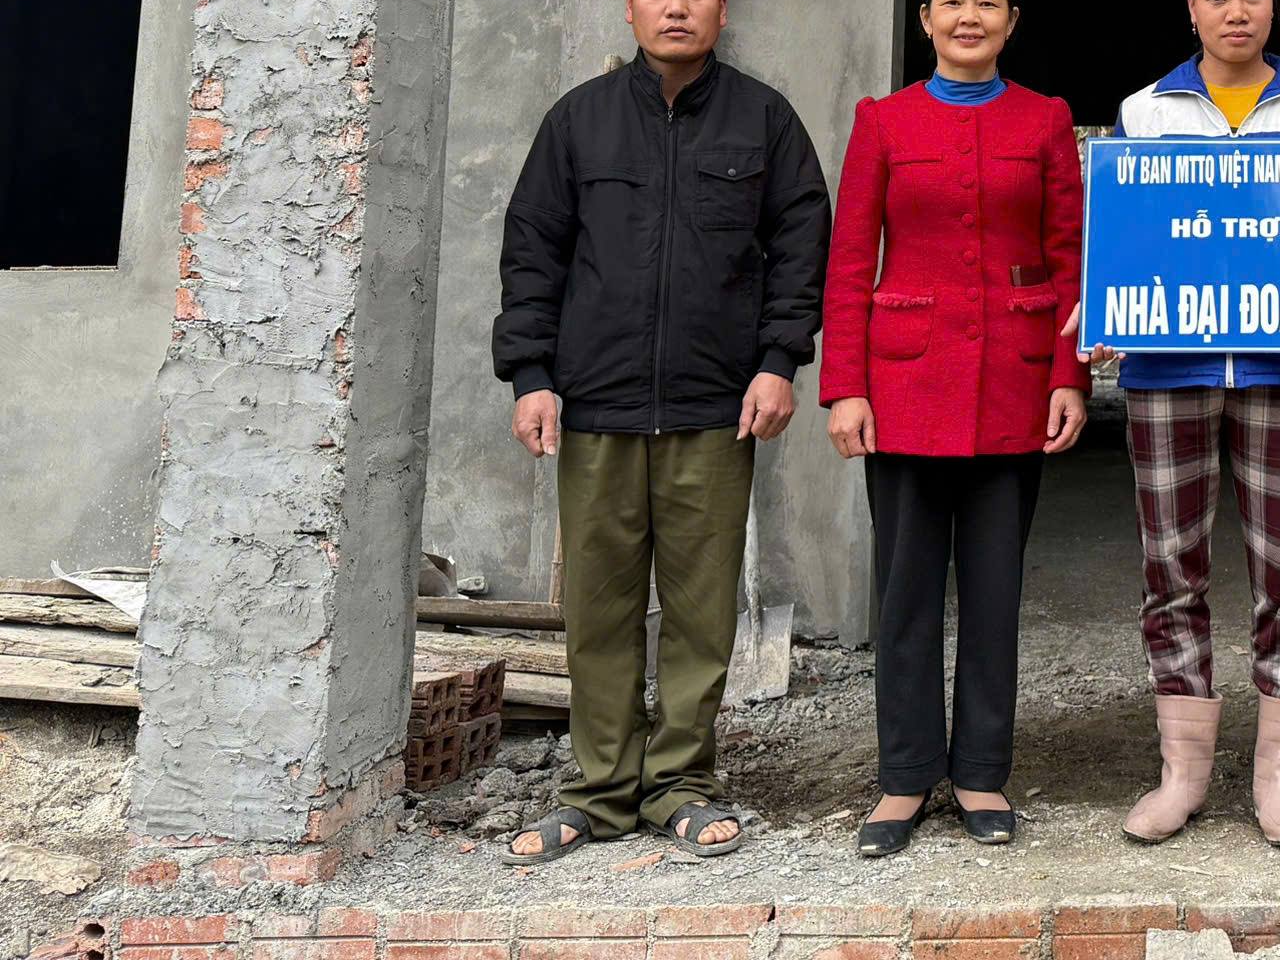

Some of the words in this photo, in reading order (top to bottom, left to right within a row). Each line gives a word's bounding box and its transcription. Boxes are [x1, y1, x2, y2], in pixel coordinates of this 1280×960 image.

[1117, 147, 1136, 185] ỦY
[1140, 155, 1171, 184] BAN
[1175, 155, 1214, 186] MTTQ
[1219, 149, 1250, 188] VIỆT
[1171, 209, 1212, 239] HỖ
[1221, 216, 1280, 242] TRỢ
[1104, 275, 1169, 336] NHÀ
[1177, 284, 1229, 343] ĐẠI
